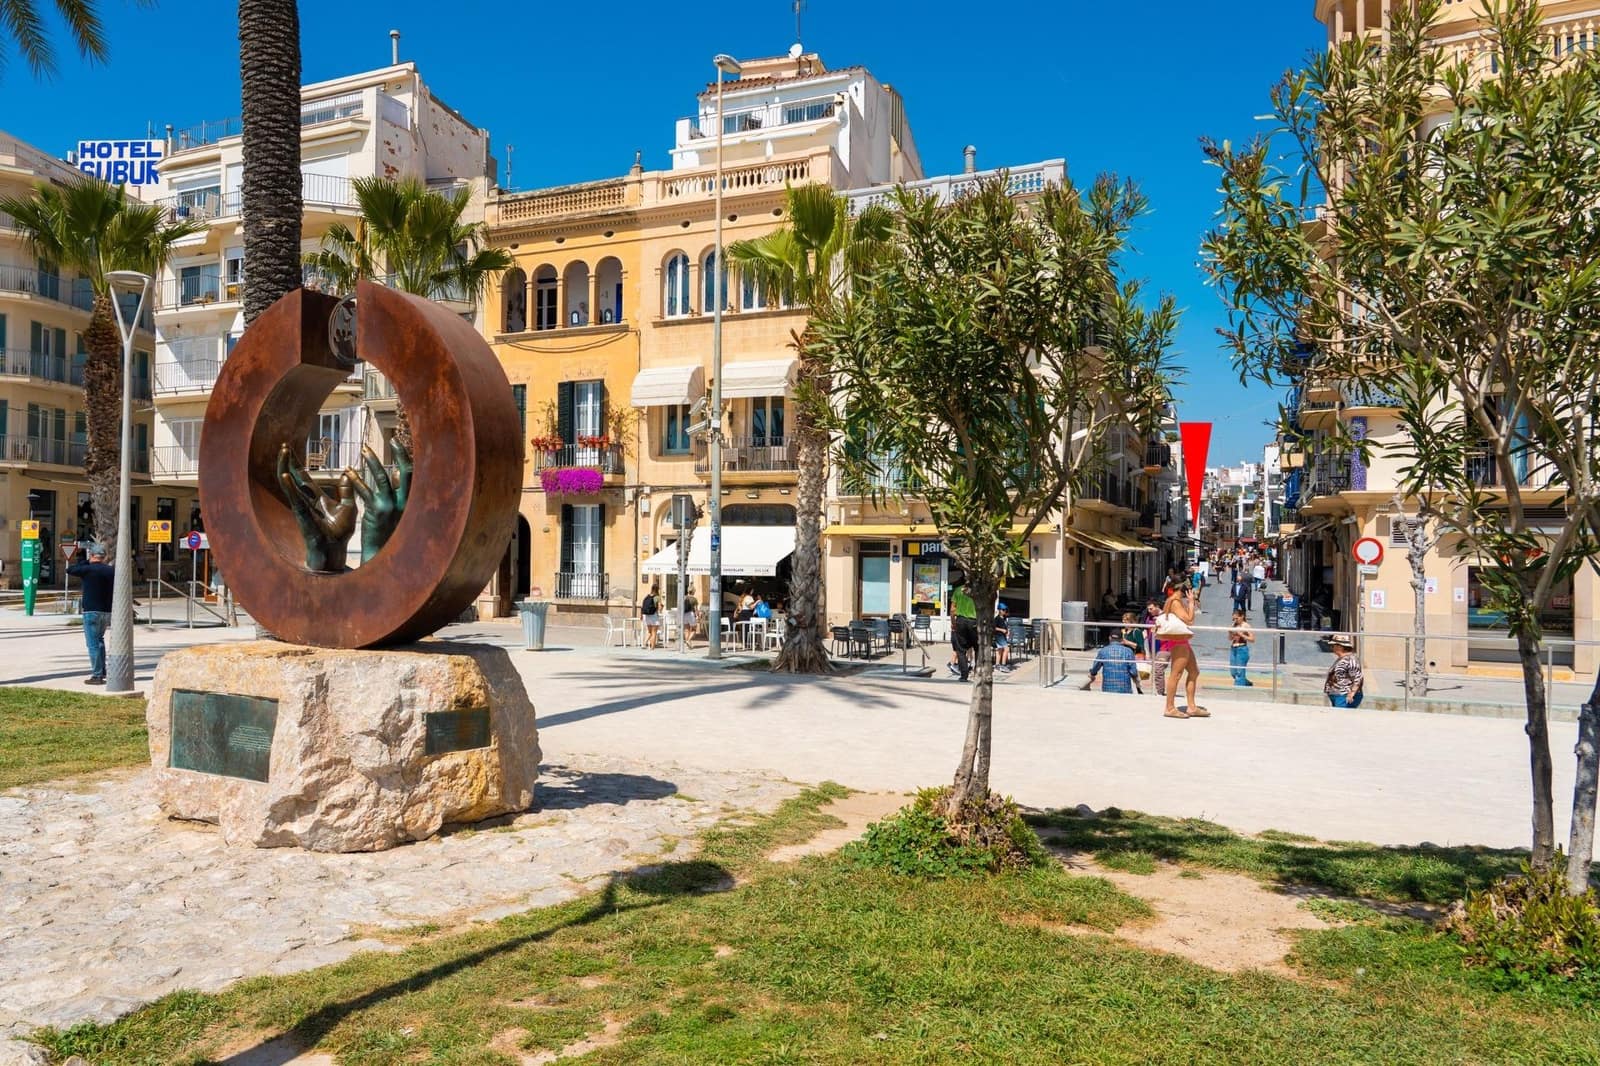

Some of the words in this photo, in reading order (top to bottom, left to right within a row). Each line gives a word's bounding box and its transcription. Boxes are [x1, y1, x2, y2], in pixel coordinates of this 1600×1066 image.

[80, 141, 162, 159] HOTEL
[80, 160, 160, 185] SUBUR
[921, 542, 945, 556] pan
